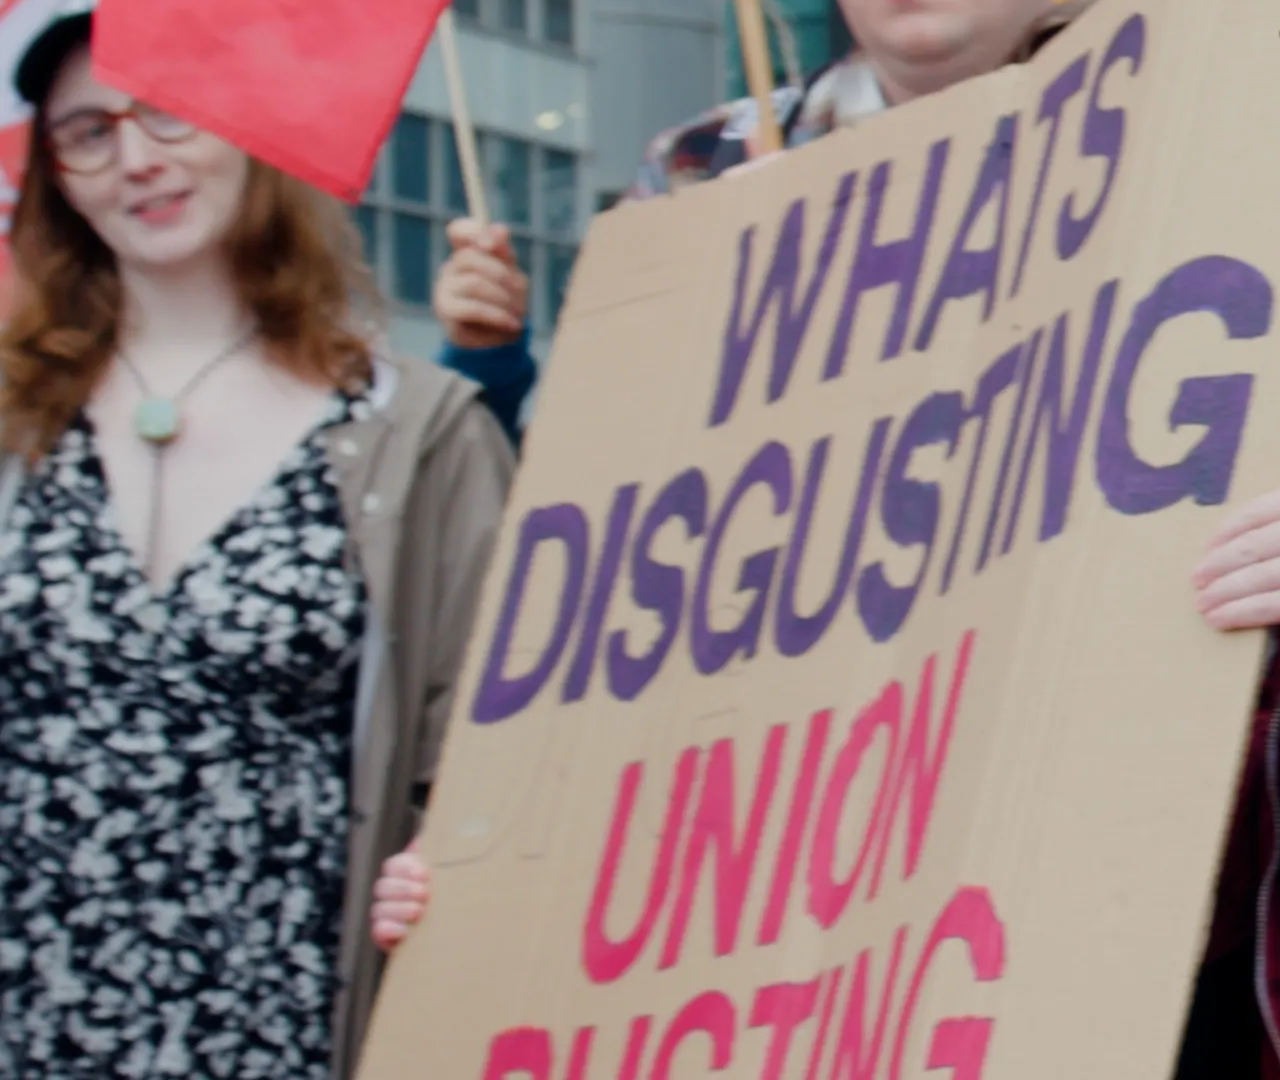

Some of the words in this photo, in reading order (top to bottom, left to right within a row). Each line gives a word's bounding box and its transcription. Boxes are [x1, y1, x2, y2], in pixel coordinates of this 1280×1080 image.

[707, 13, 1147, 427] WHATS
[470, 255, 1273, 722] DISGUSTING
[482, 885, 1006, 1080] TING
[581, 629, 975, 984] UNION
